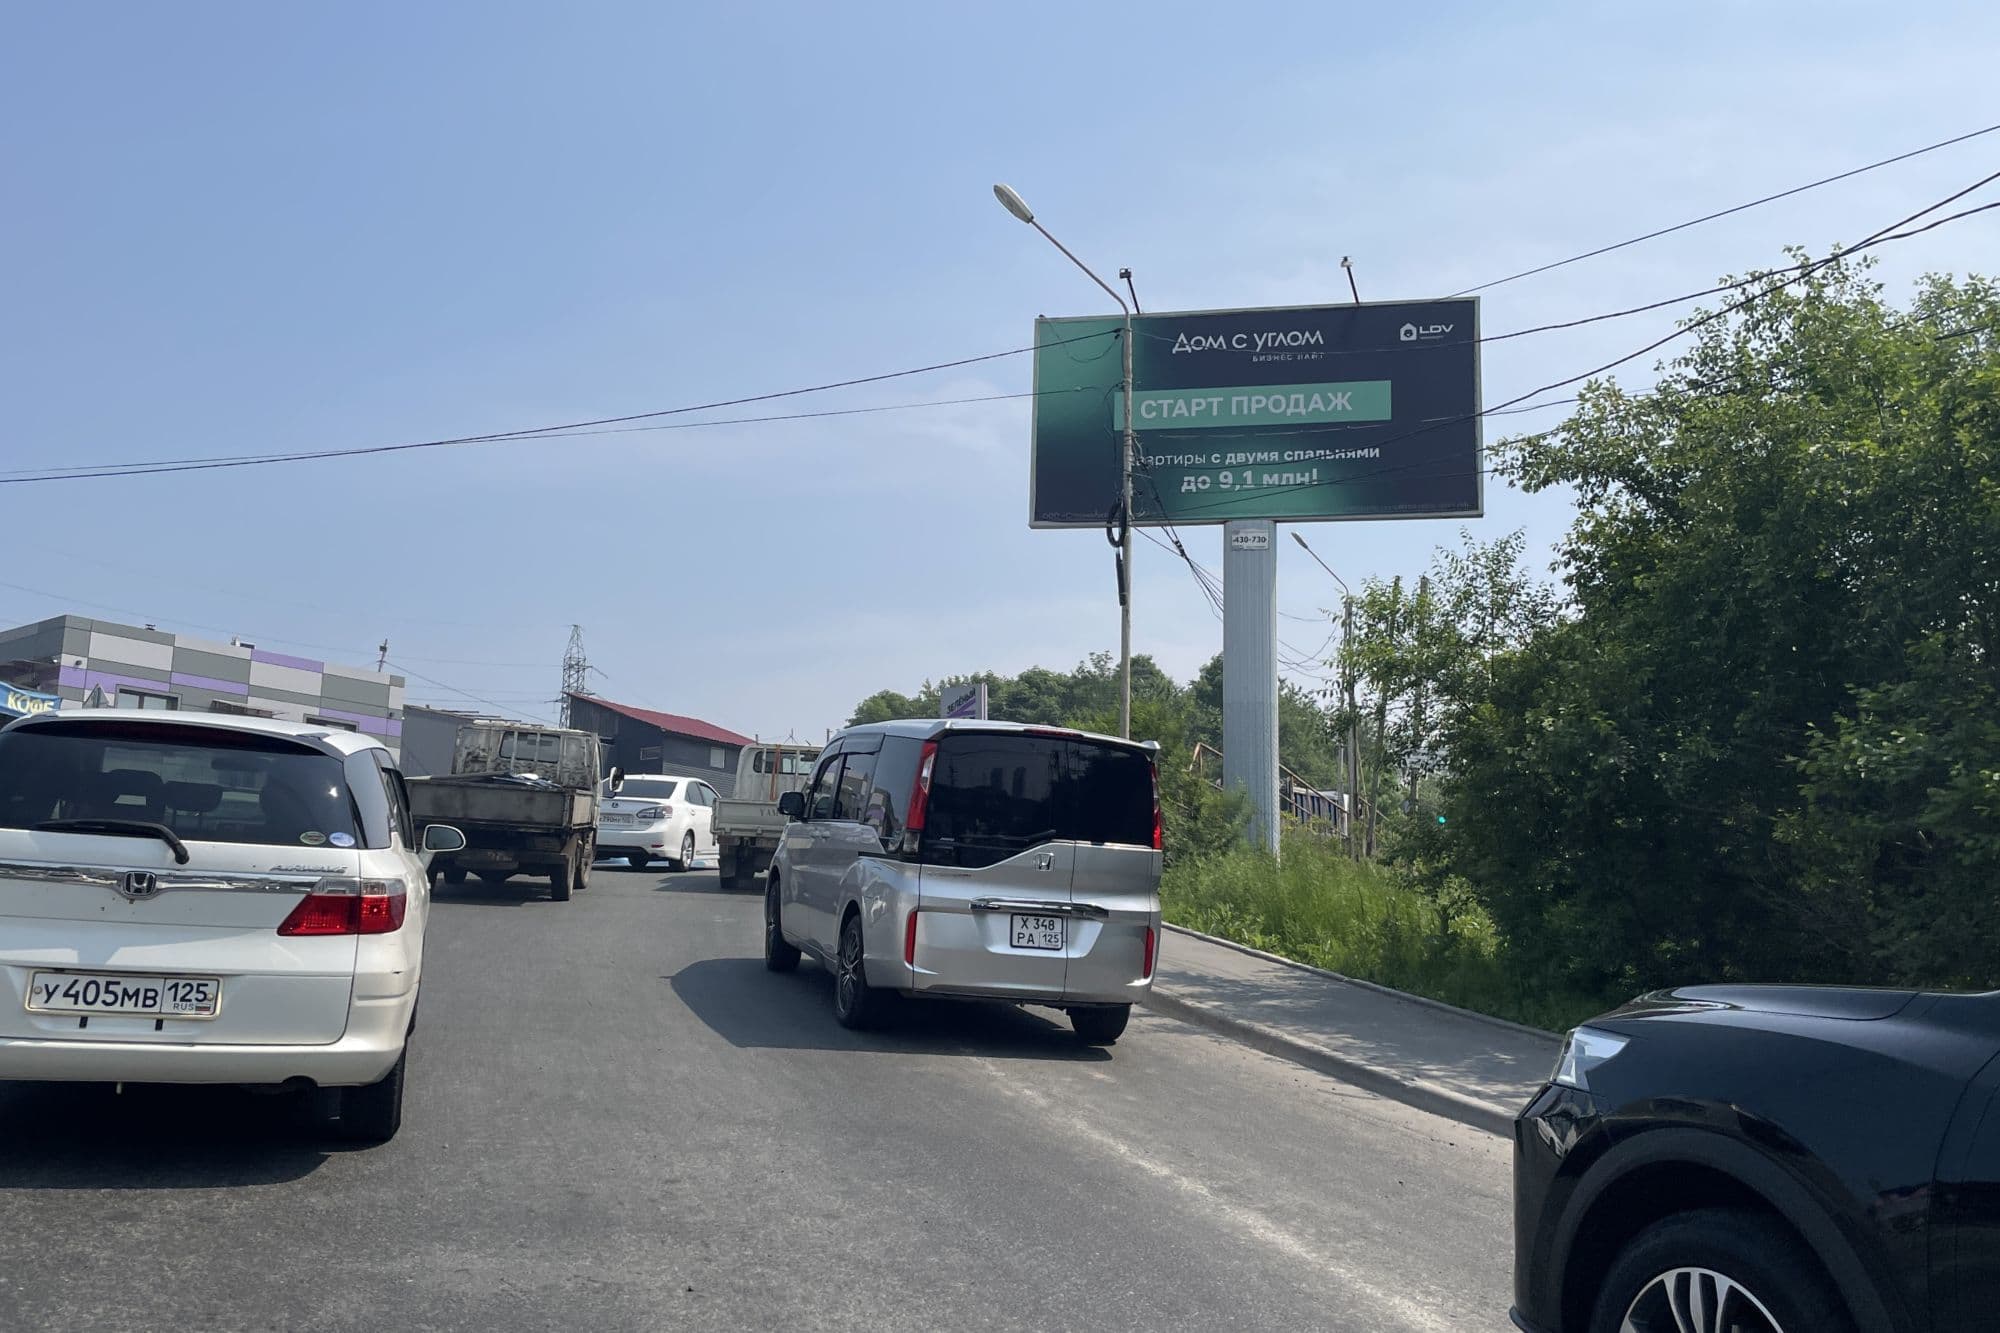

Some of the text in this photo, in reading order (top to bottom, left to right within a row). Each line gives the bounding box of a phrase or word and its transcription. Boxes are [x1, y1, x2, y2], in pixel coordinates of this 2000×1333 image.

[1140, 392, 1352, 419] СТАРТ ПРОДАЖ
[1211, 453, 1221, 463] с
[1225, 452, 1279, 465] двумя
[1284, 447, 1380, 461] спальнями
[1181, 468, 1318, 493] до 9,1 млн!
[1033, 918, 1055, 931] 348
[1042, 933, 1060, 944] 125
[167, 982, 209, 1003] 125
[173, 1002, 194, 1011] RUS
